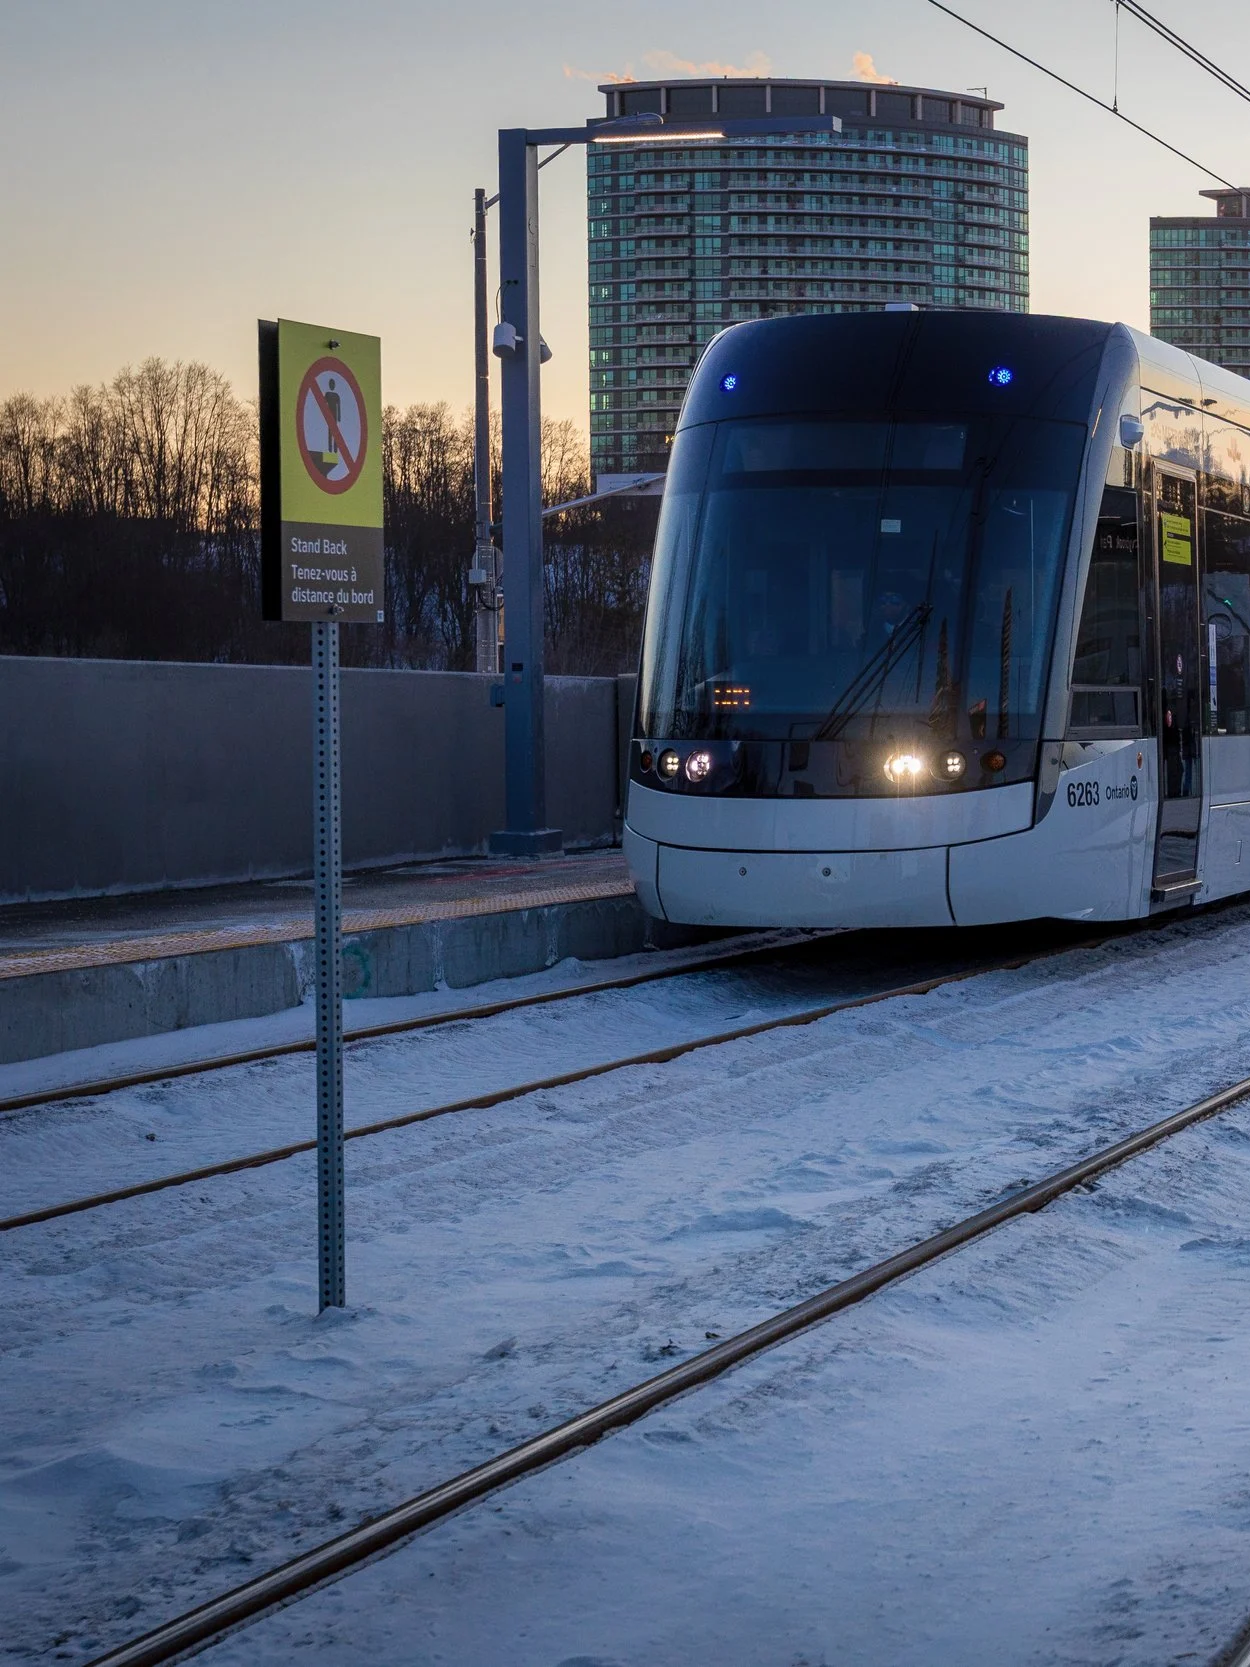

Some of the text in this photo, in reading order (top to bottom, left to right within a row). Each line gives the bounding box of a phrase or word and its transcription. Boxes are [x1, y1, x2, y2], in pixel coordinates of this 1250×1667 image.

[291, 537, 347, 555] Stand Back
[291, 564, 357, 581] Tenez-vous à
[291, 587, 374, 604] distance du bord
[1067, 781, 1100, 808] 6263
[1105, 784, 1130, 800] Ontario
